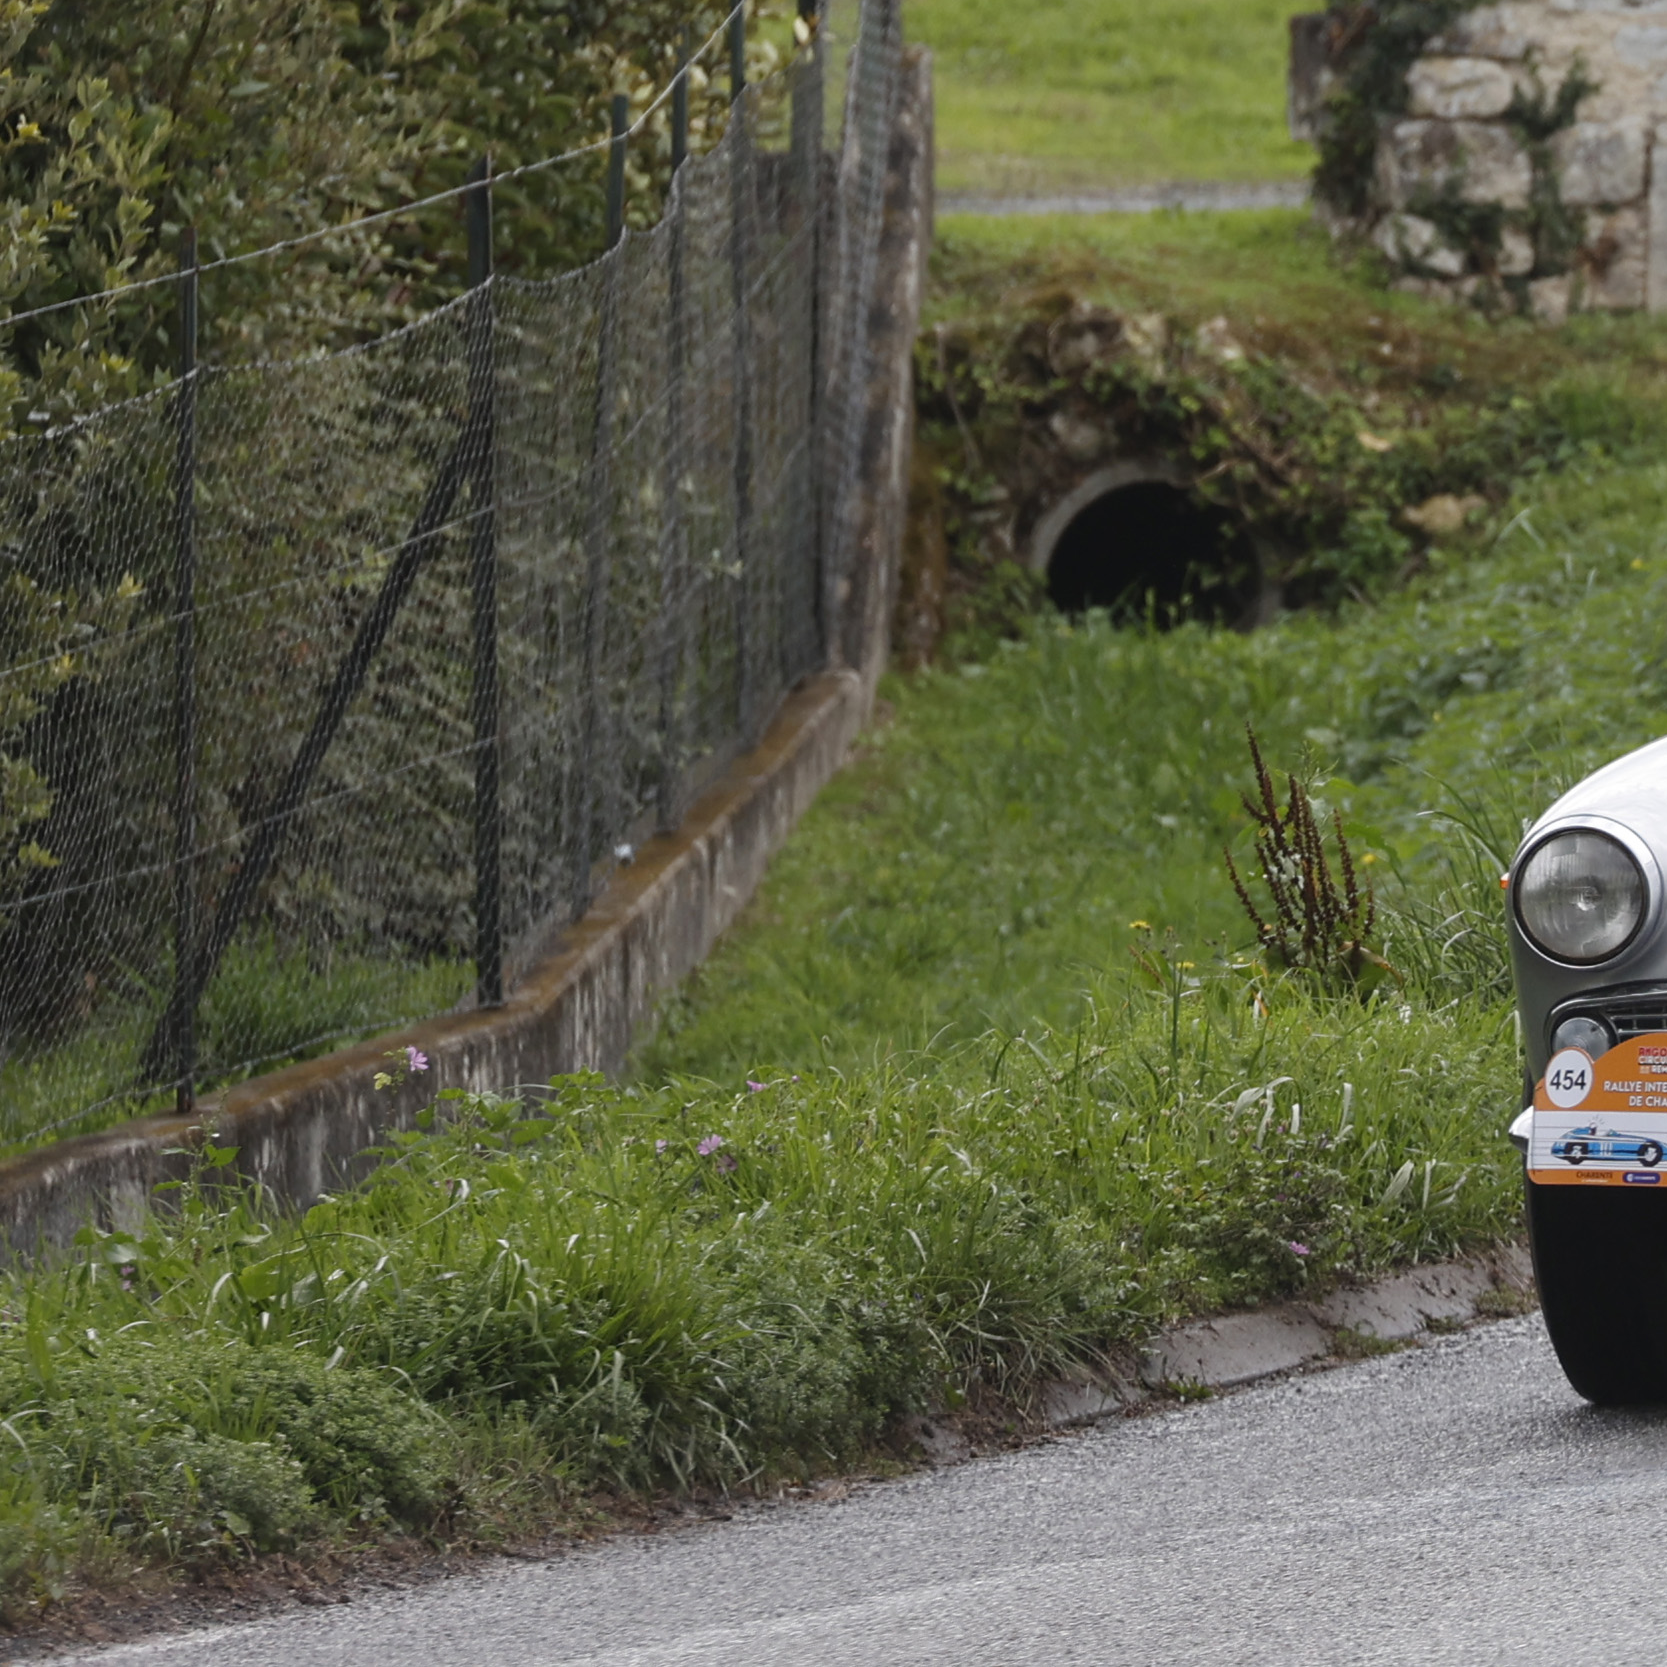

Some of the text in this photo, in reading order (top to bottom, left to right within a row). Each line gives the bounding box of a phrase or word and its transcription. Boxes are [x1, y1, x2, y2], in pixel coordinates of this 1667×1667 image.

[1550, 1069, 1586, 1090] 454
[1604, 1080, 1642, 1092] RALLYE
[1629, 1096, 1643, 1106] DE
